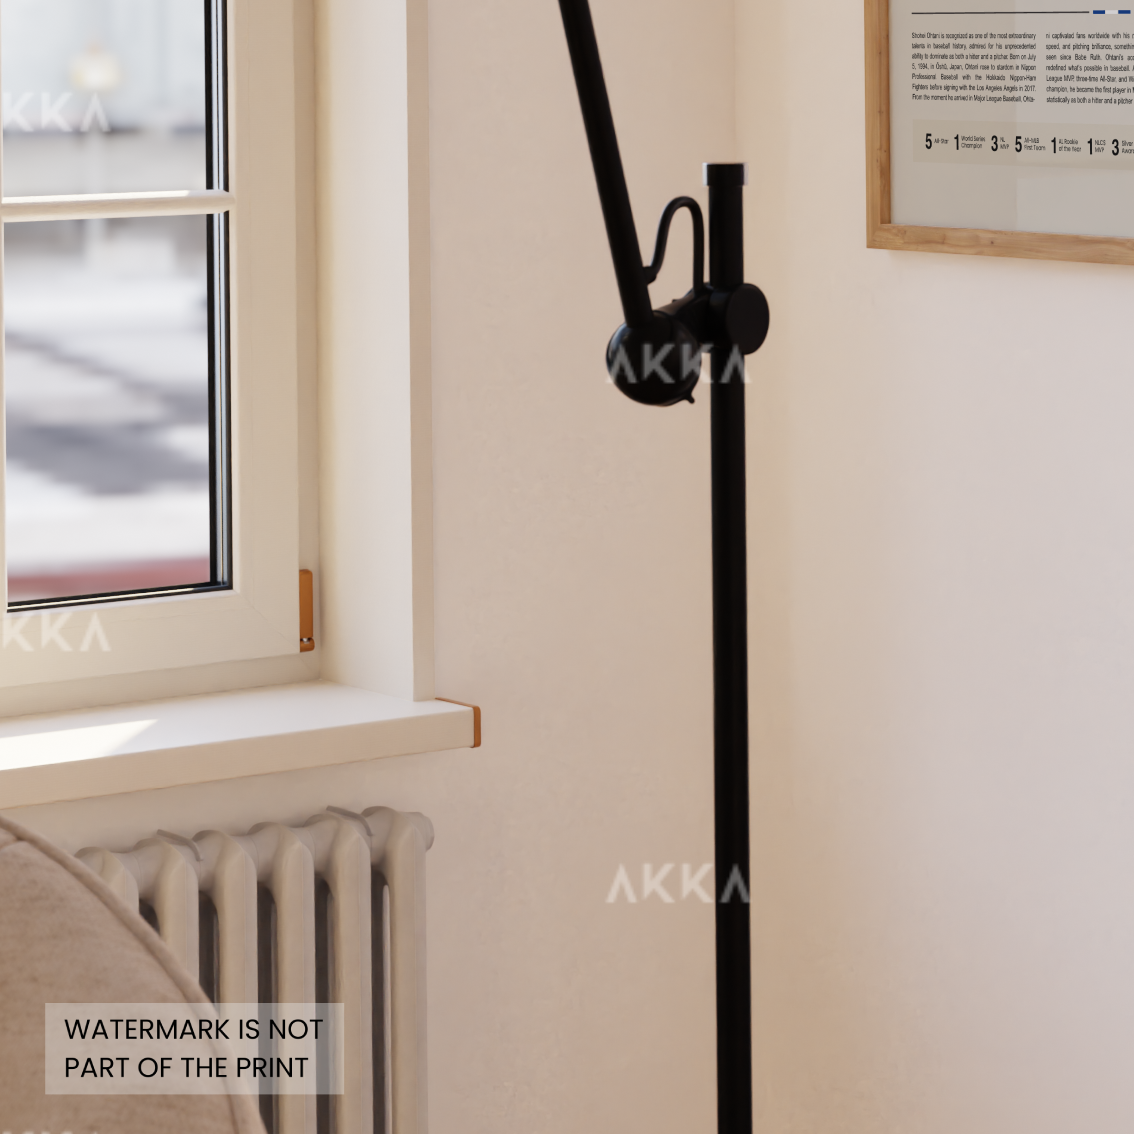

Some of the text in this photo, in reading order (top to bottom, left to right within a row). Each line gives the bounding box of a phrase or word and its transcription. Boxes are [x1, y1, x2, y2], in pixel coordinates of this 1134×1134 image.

[925, 133, 932, 149] 5
[954, 134, 959, 150] 1
[991, 135, 998, 151] 3
[1015, 136, 1022, 152] 5
[1051, 137, 1056, 153] 1
[1087, 138, 1092, 155] 1
[1112, 139, 1119, 156] 3
